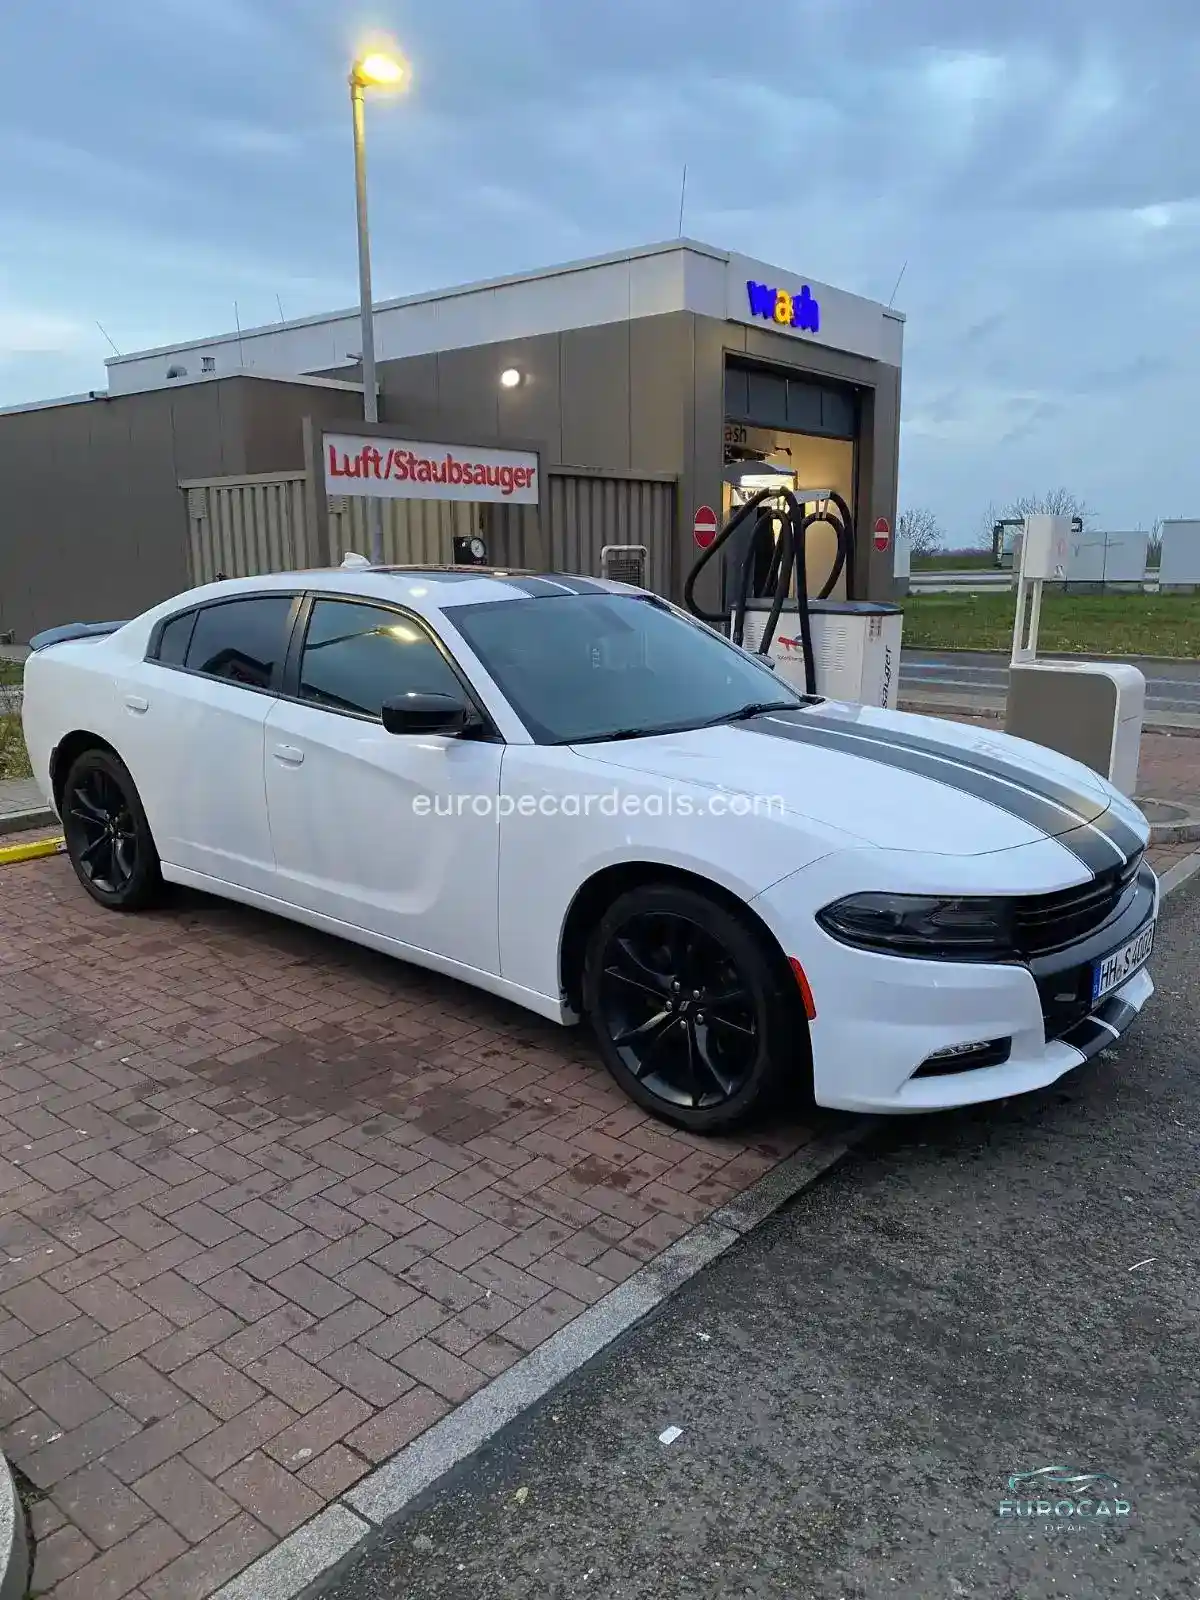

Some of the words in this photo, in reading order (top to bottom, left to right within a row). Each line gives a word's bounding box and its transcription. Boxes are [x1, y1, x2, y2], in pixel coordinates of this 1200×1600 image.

[746, 279, 820, 333] wash
[328, 444, 536, 496] Luft/Staubsauger
[1100, 955, 1118, 991] HH
[1123, 947, 1131, 975] S
